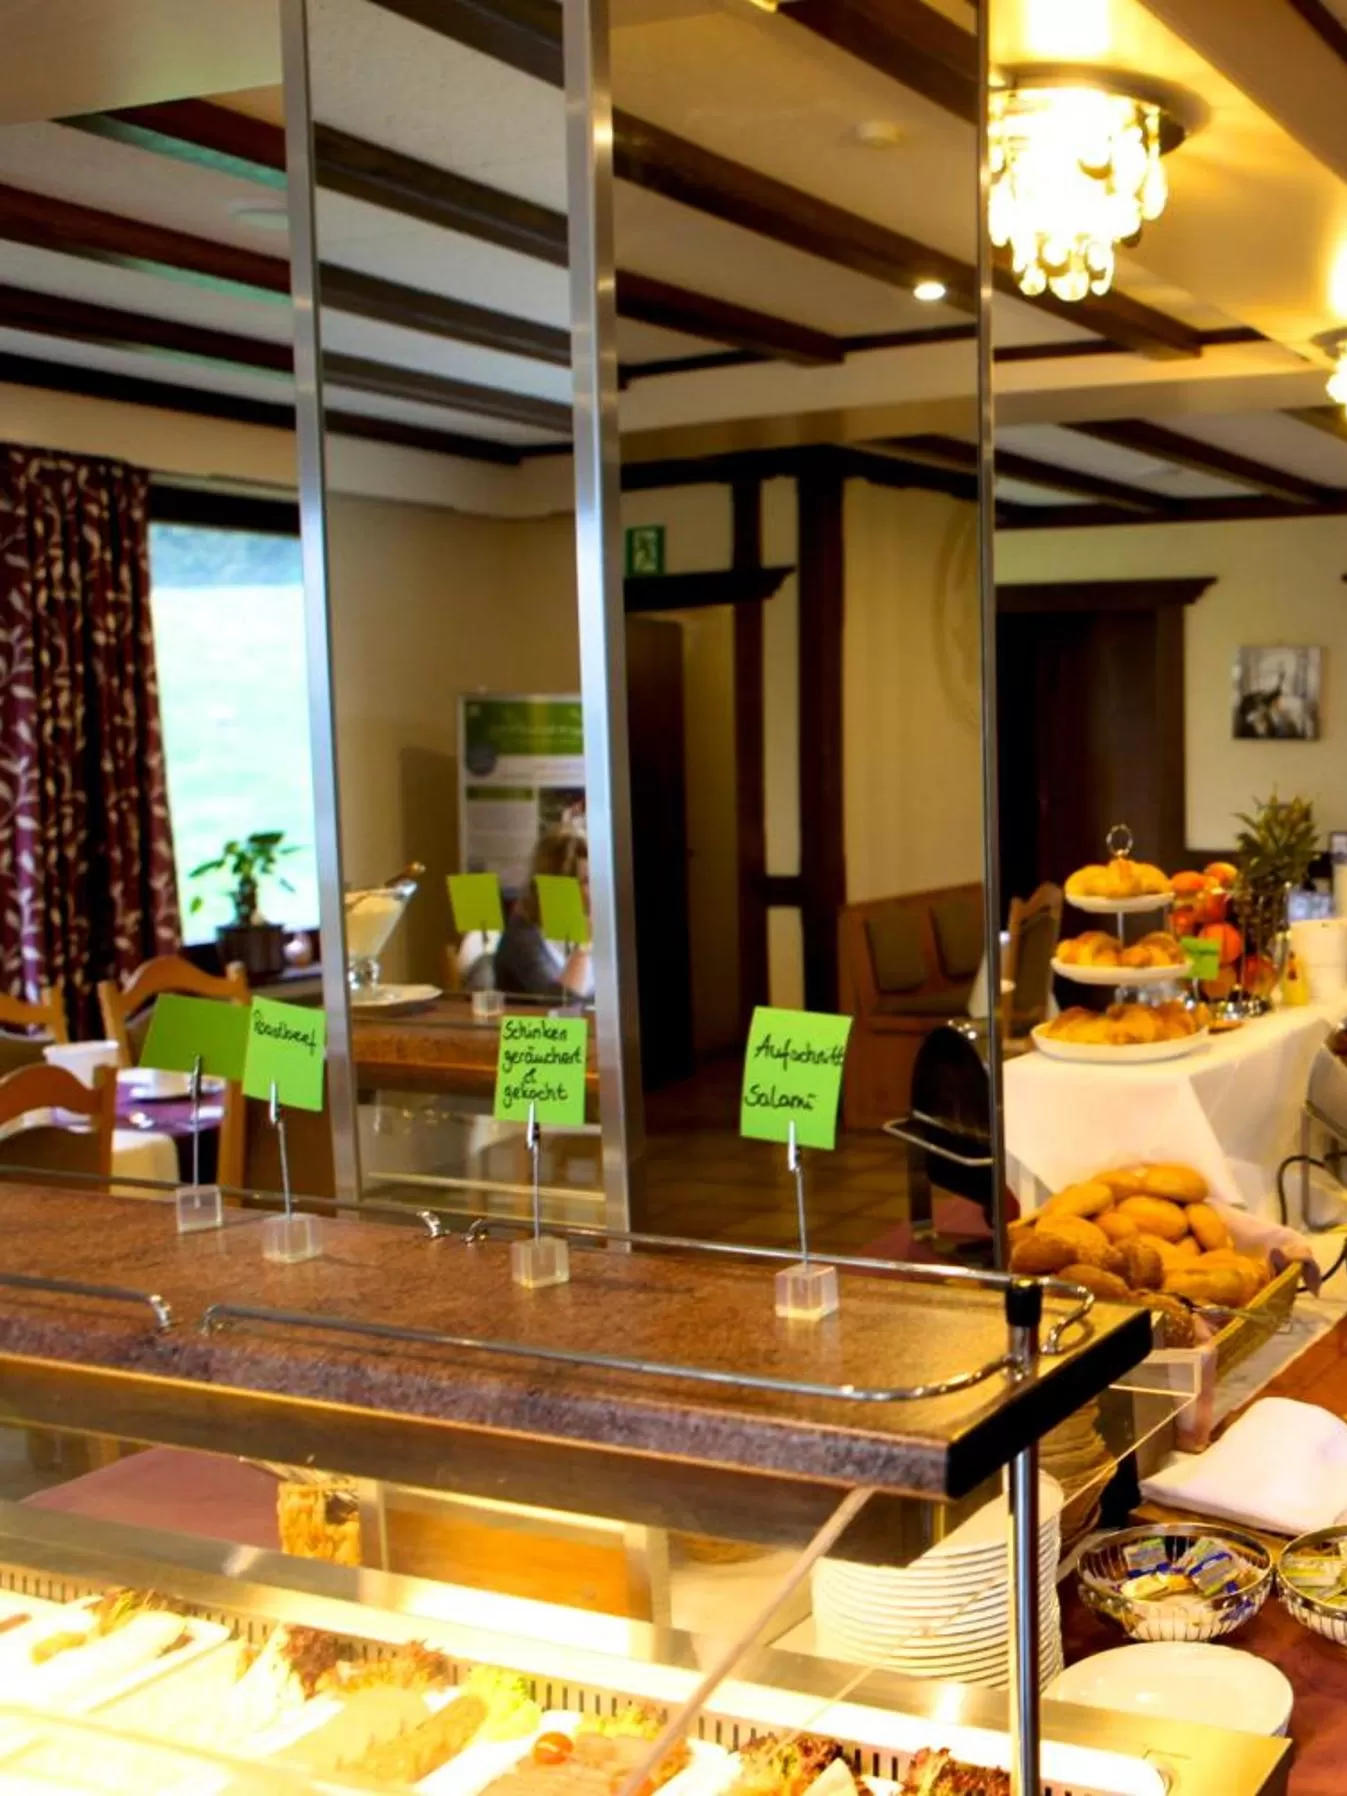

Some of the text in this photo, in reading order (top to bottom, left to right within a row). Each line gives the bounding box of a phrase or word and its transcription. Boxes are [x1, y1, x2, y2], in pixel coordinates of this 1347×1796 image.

[502, 1019, 569, 1041] Schinken
[502, 1046, 583, 1074] geräuchert
[502, 1082, 569, 1109] gekocht
[744, 1085, 817, 1111] Salami
